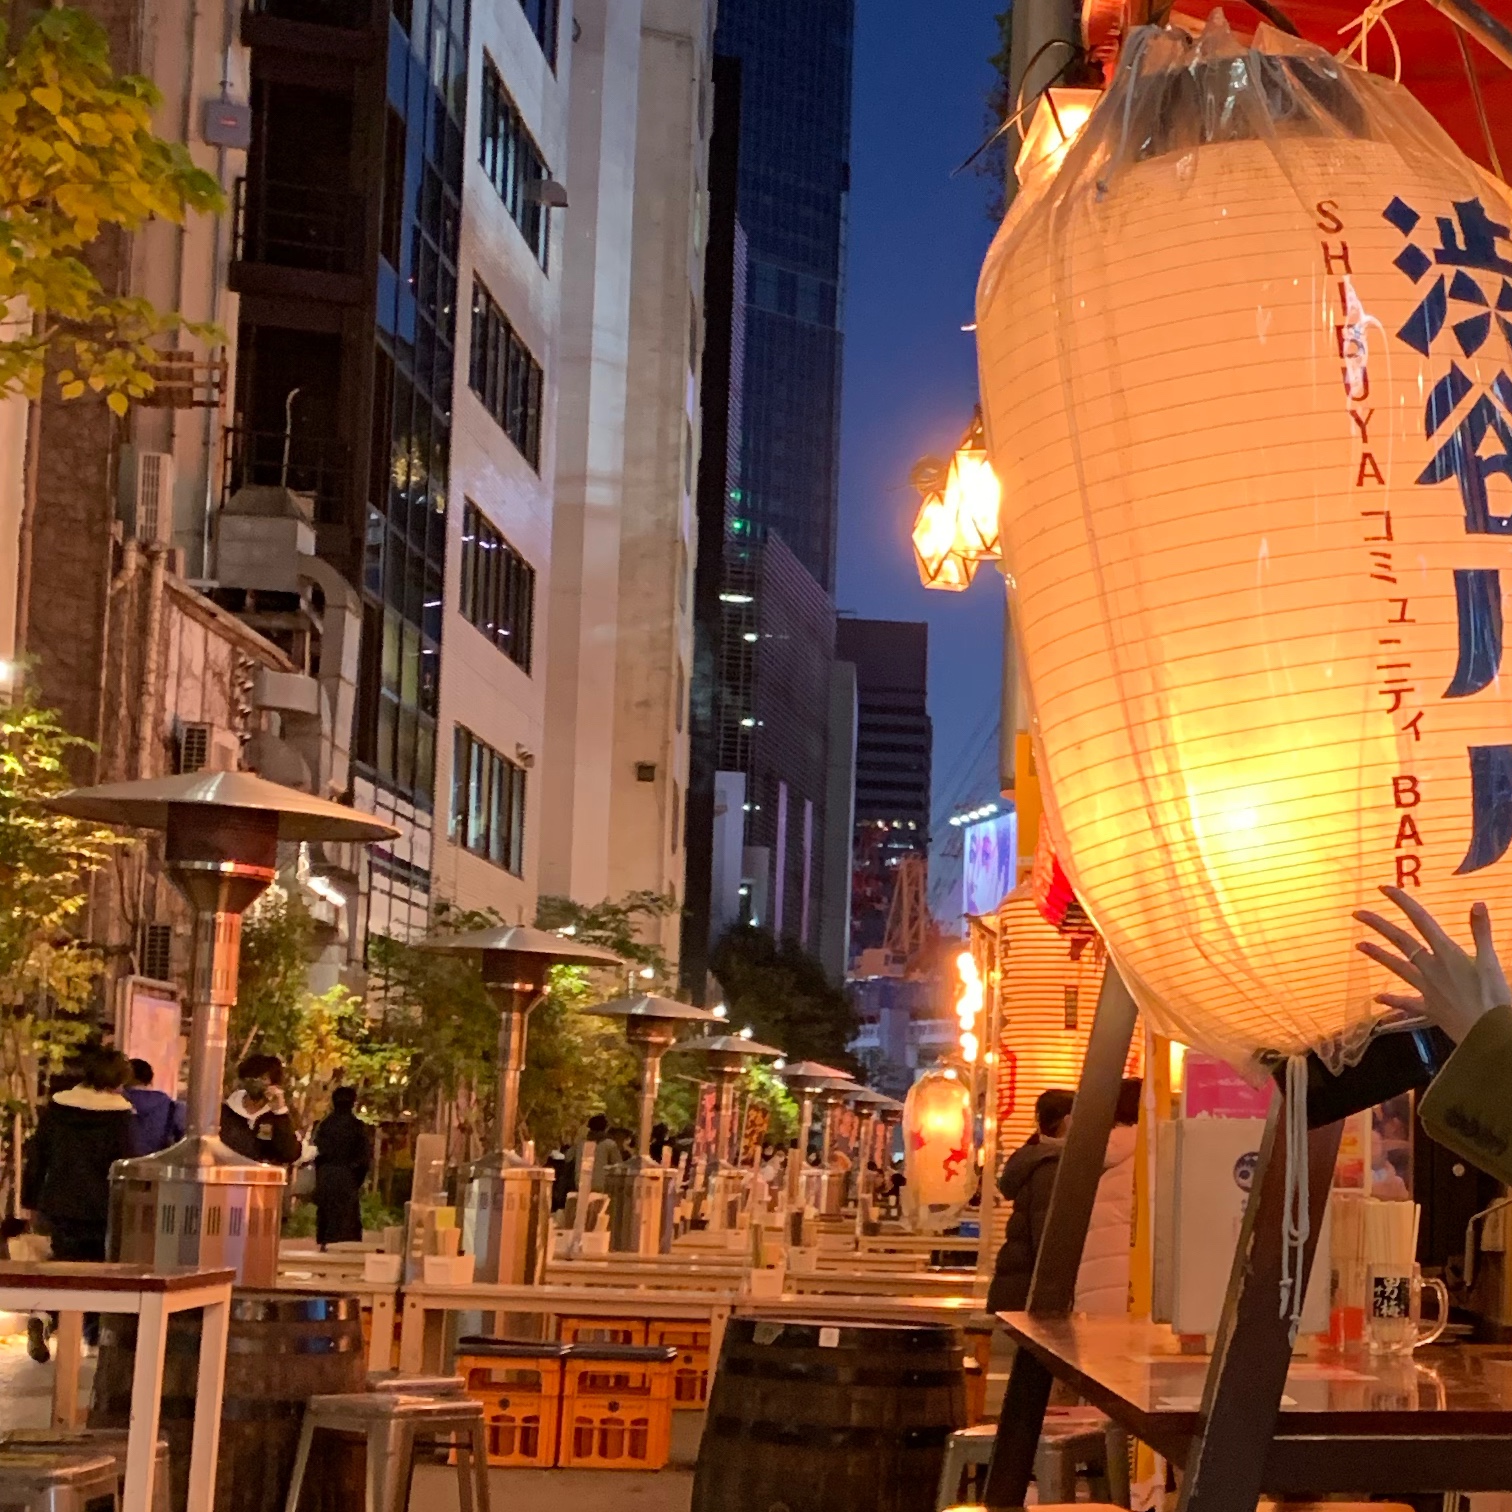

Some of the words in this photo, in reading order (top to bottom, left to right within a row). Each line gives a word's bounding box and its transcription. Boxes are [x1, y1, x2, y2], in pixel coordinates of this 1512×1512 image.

[1315, 199, 1385, 488] SHIBUYA
[1361, 510, 1423, 743] コミュニティ
[1391, 774, 1422, 889] BAR
